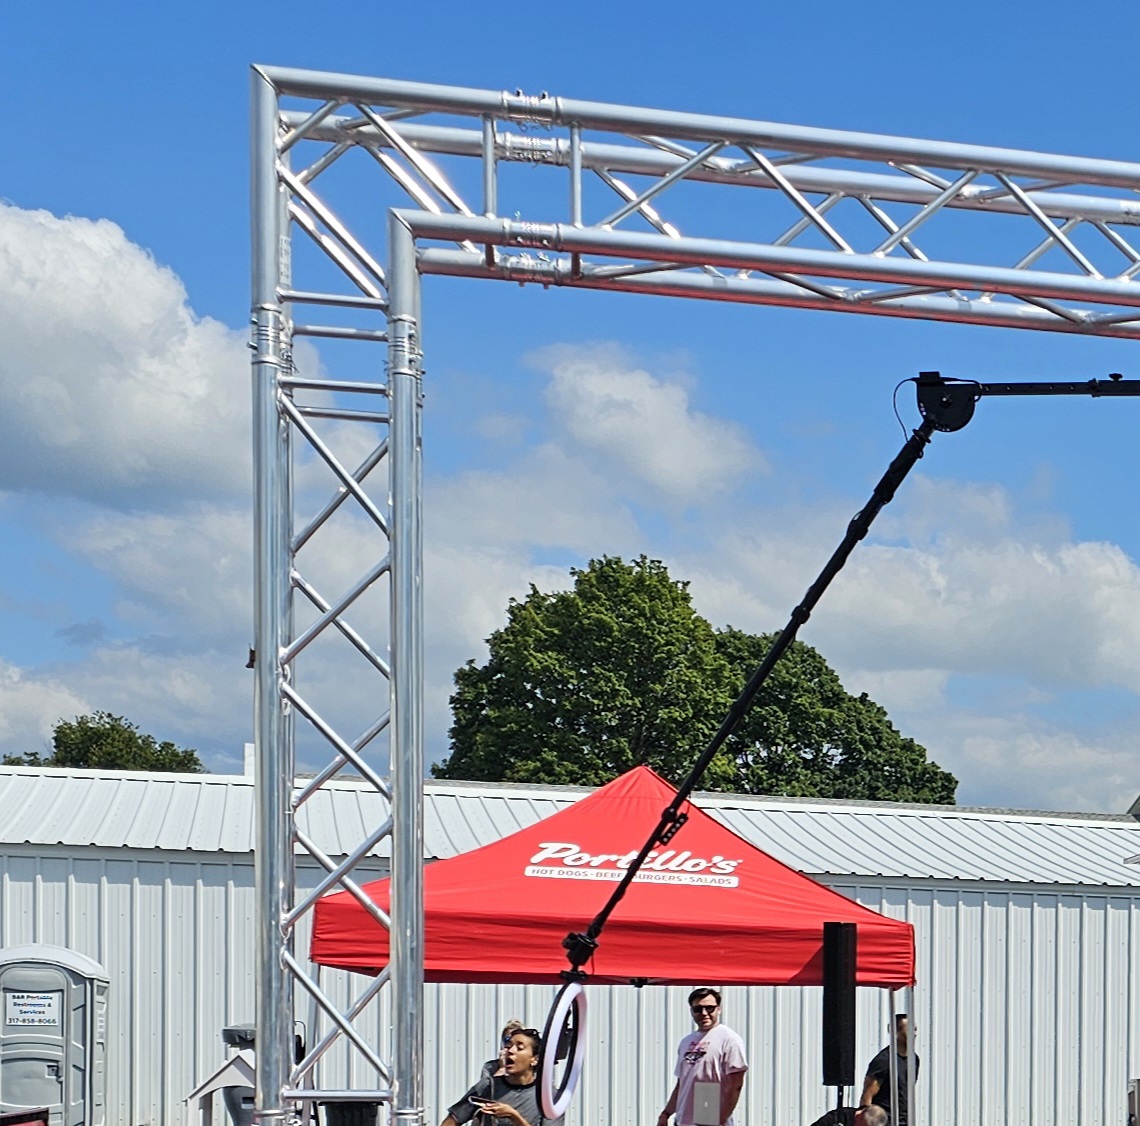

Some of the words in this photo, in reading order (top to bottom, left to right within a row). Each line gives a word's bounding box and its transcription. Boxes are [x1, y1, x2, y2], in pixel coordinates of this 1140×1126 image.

[530, 842, 738, 874] Portillo's
[531, 868, 556, 876] HOT
[558, 869, 588, 877] DOGS
[595, 871, 623, 879] BEEF
[634, 873, 683, 882] URGERS
[689, 876, 732, 885] SALADS
